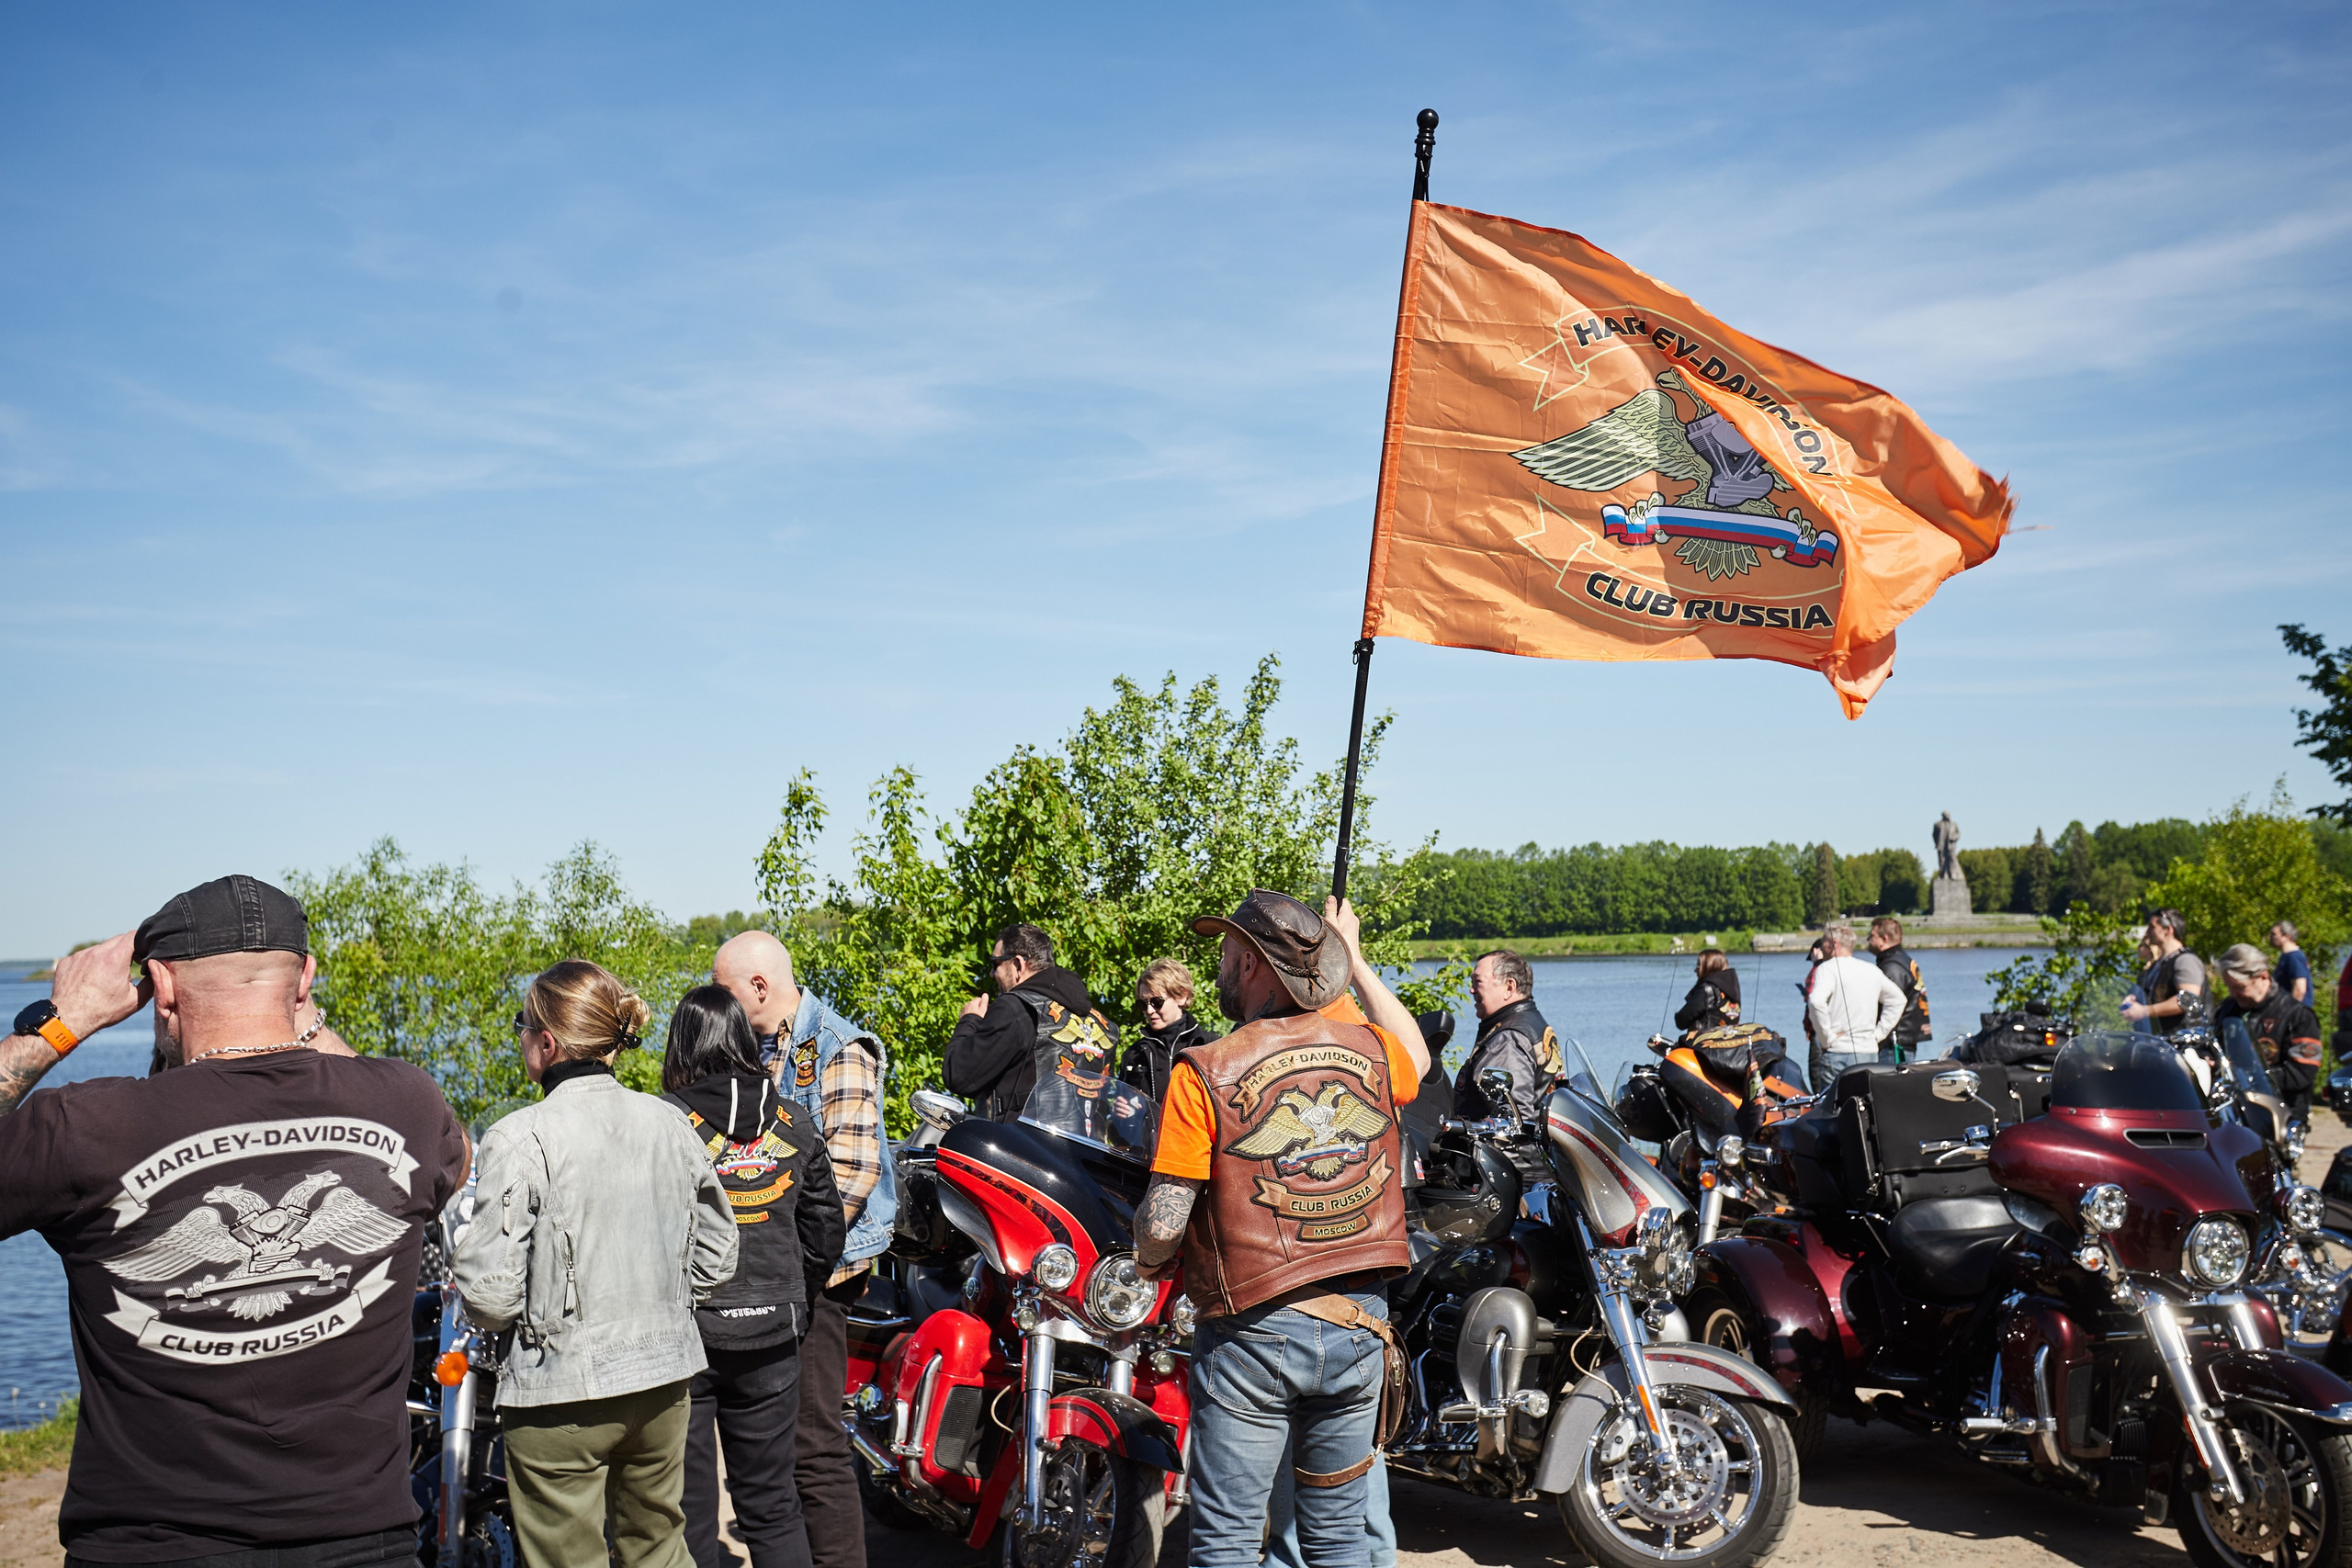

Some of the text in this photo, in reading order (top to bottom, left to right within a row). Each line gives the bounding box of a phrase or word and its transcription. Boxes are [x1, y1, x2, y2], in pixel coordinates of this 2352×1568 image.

[1570, 315, 1835, 478] HAREY-DAVIDON
[1585, 570, 1835, 631] CLUB RUSSIA
[1247, 1051, 1368, 1089] HARLEY-DAVIDSON
[133, 1124, 398, 1191] HARLEY-DAVIDSON
[728, 1189, 777, 1203] UB RUSSIA
[1290, 1185, 1374, 1213] CLUB RUSSIA
[1314, 1222, 1357, 1237] MOSCOW
[159, 1313, 346, 1357] CLUB RUSSIA
